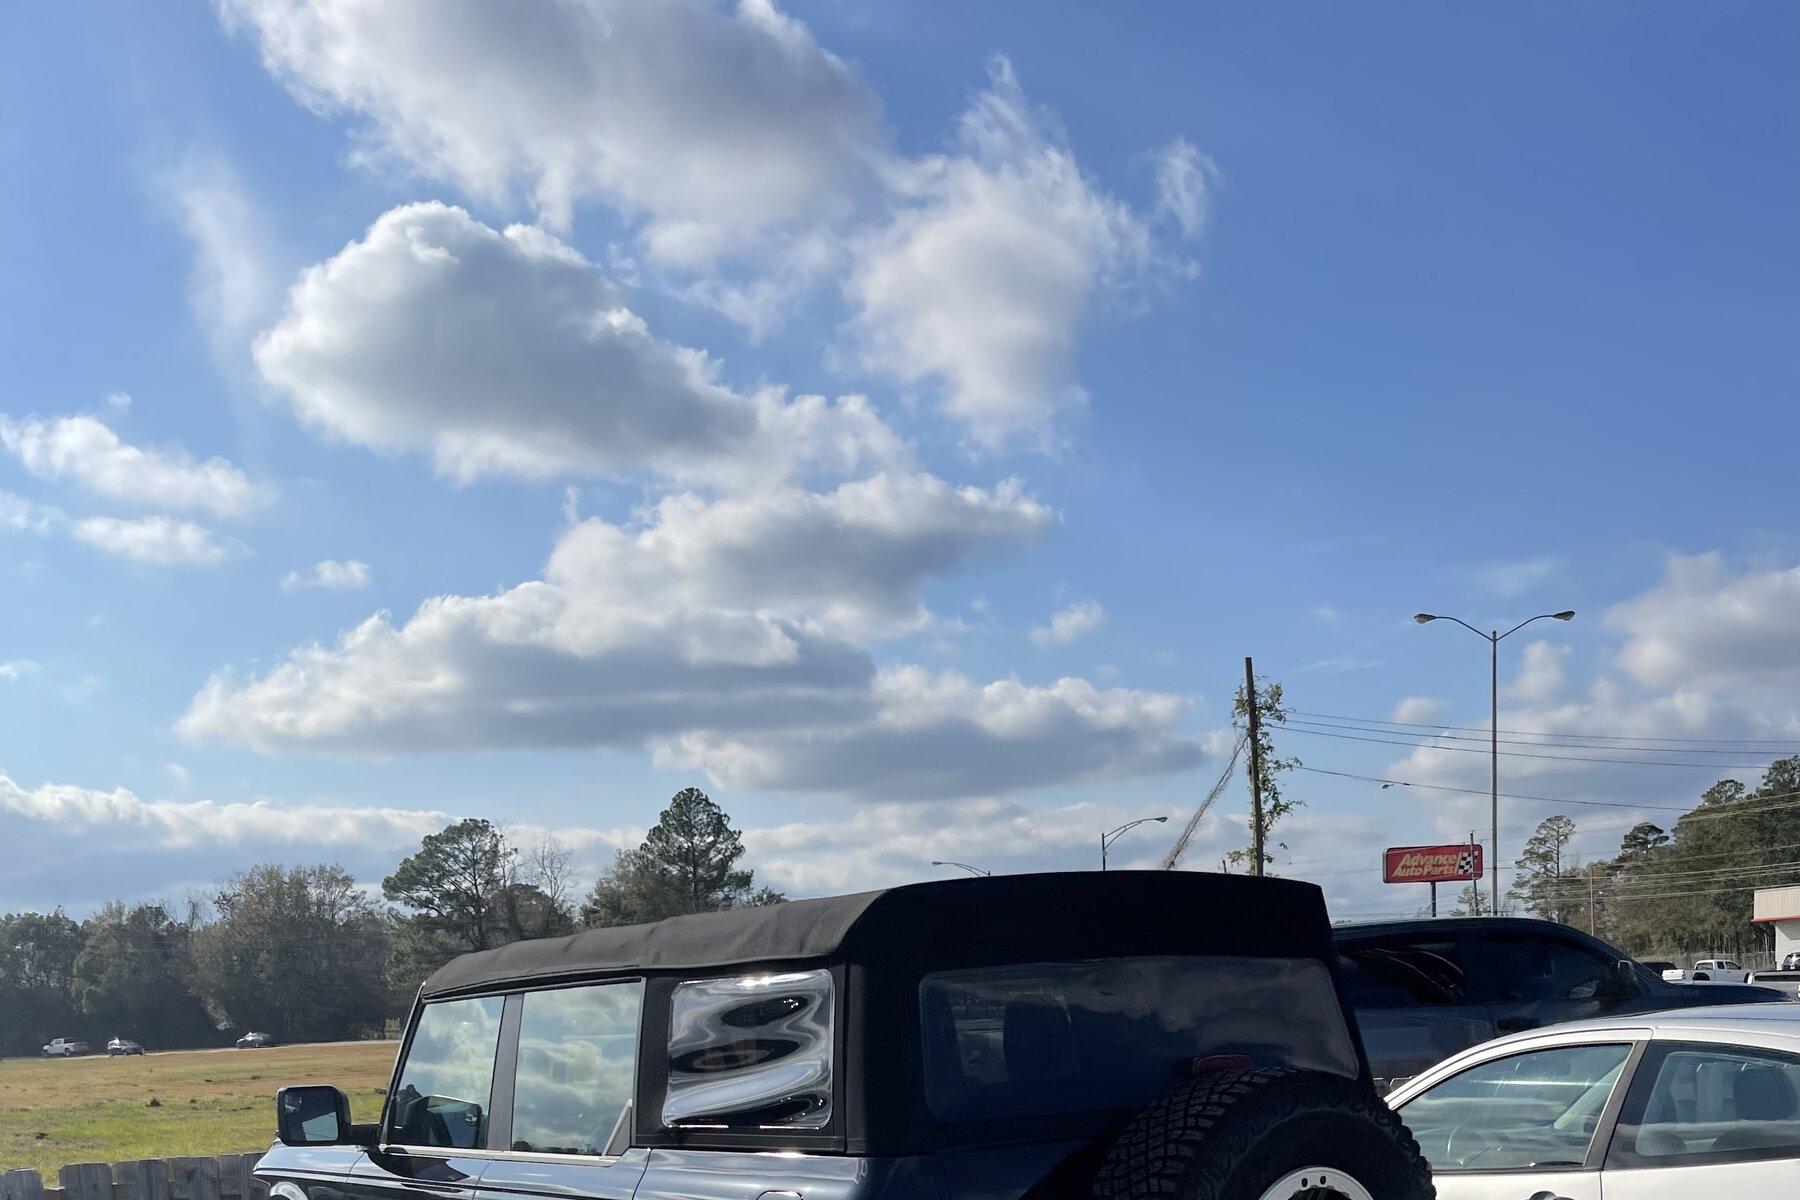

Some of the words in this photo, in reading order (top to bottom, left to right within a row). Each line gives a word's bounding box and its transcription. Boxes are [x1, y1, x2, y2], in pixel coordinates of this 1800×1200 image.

[1400, 854, 1457, 866] Advance
[1392, 865, 1422, 878] Auto
[1422, 864, 1455, 876] Parts
